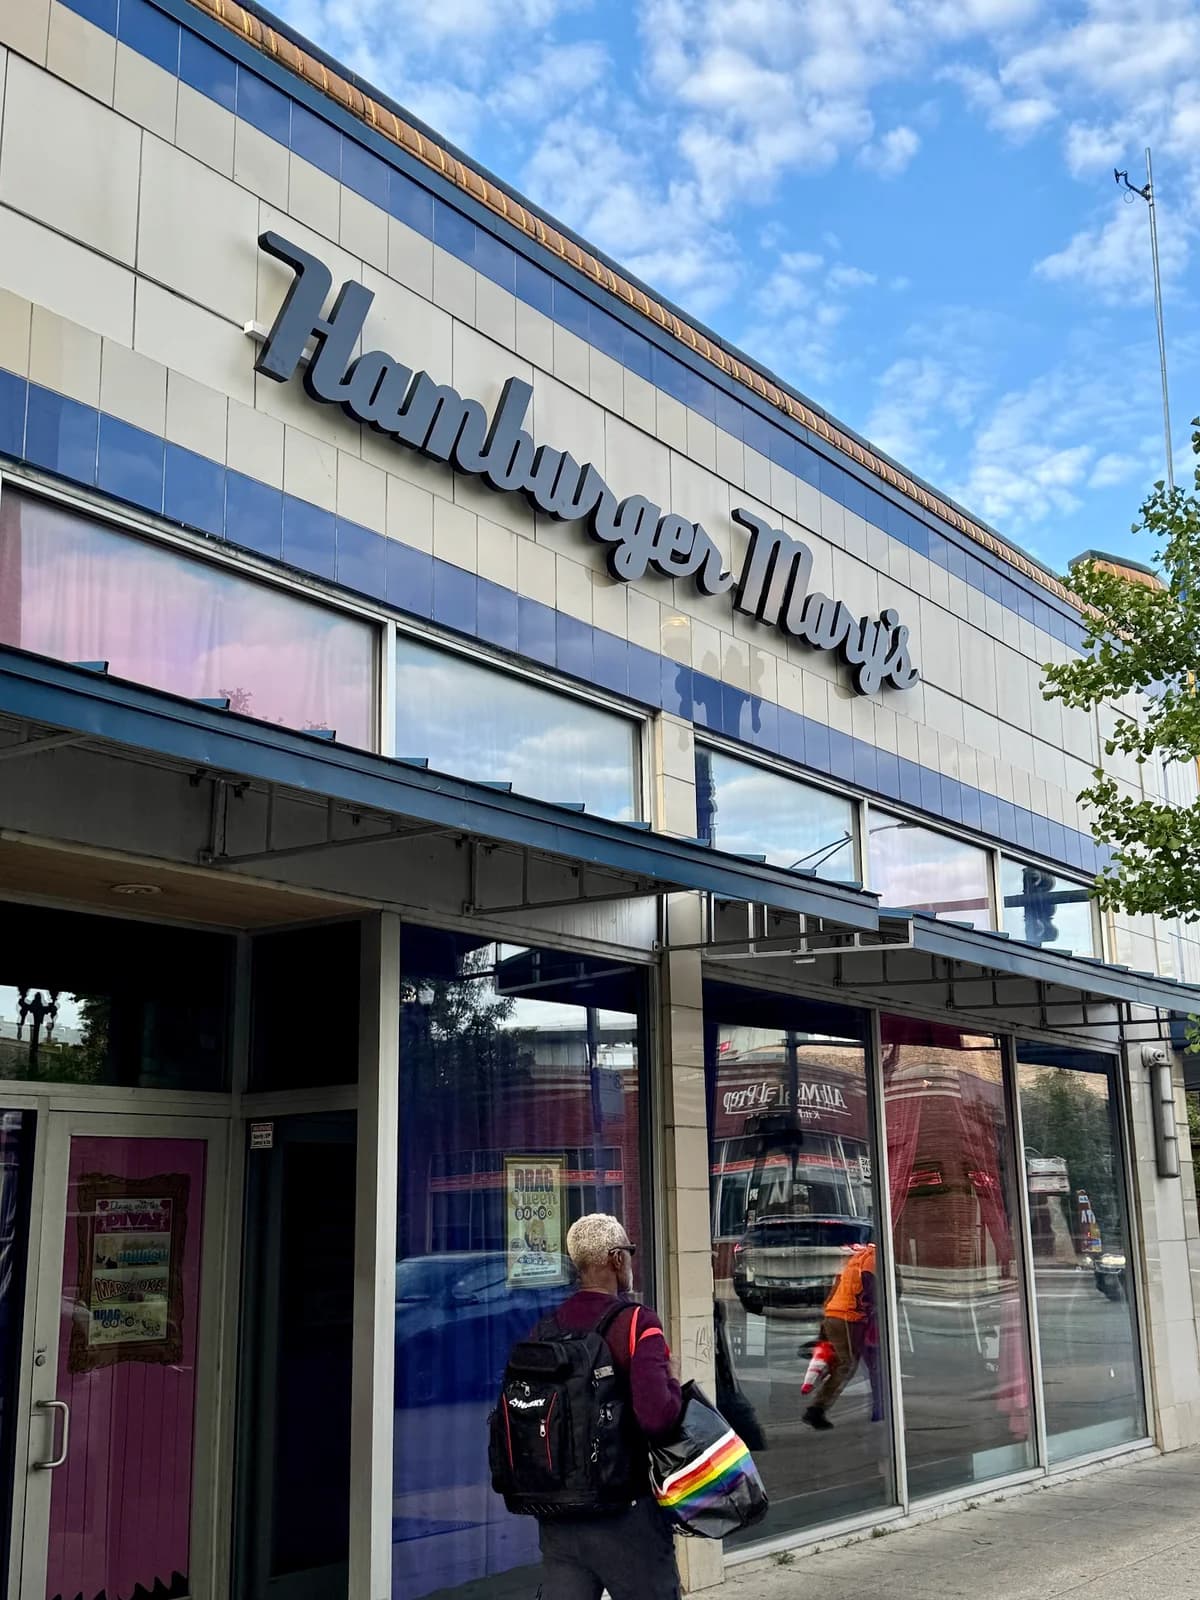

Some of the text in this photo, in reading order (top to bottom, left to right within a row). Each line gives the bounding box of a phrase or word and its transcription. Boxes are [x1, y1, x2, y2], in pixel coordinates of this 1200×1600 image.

[253, 231, 920, 696] Hamburger Mary's
[514, 1168, 554, 1192] DRAG
[511, 1191, 558, 1206] Queen
